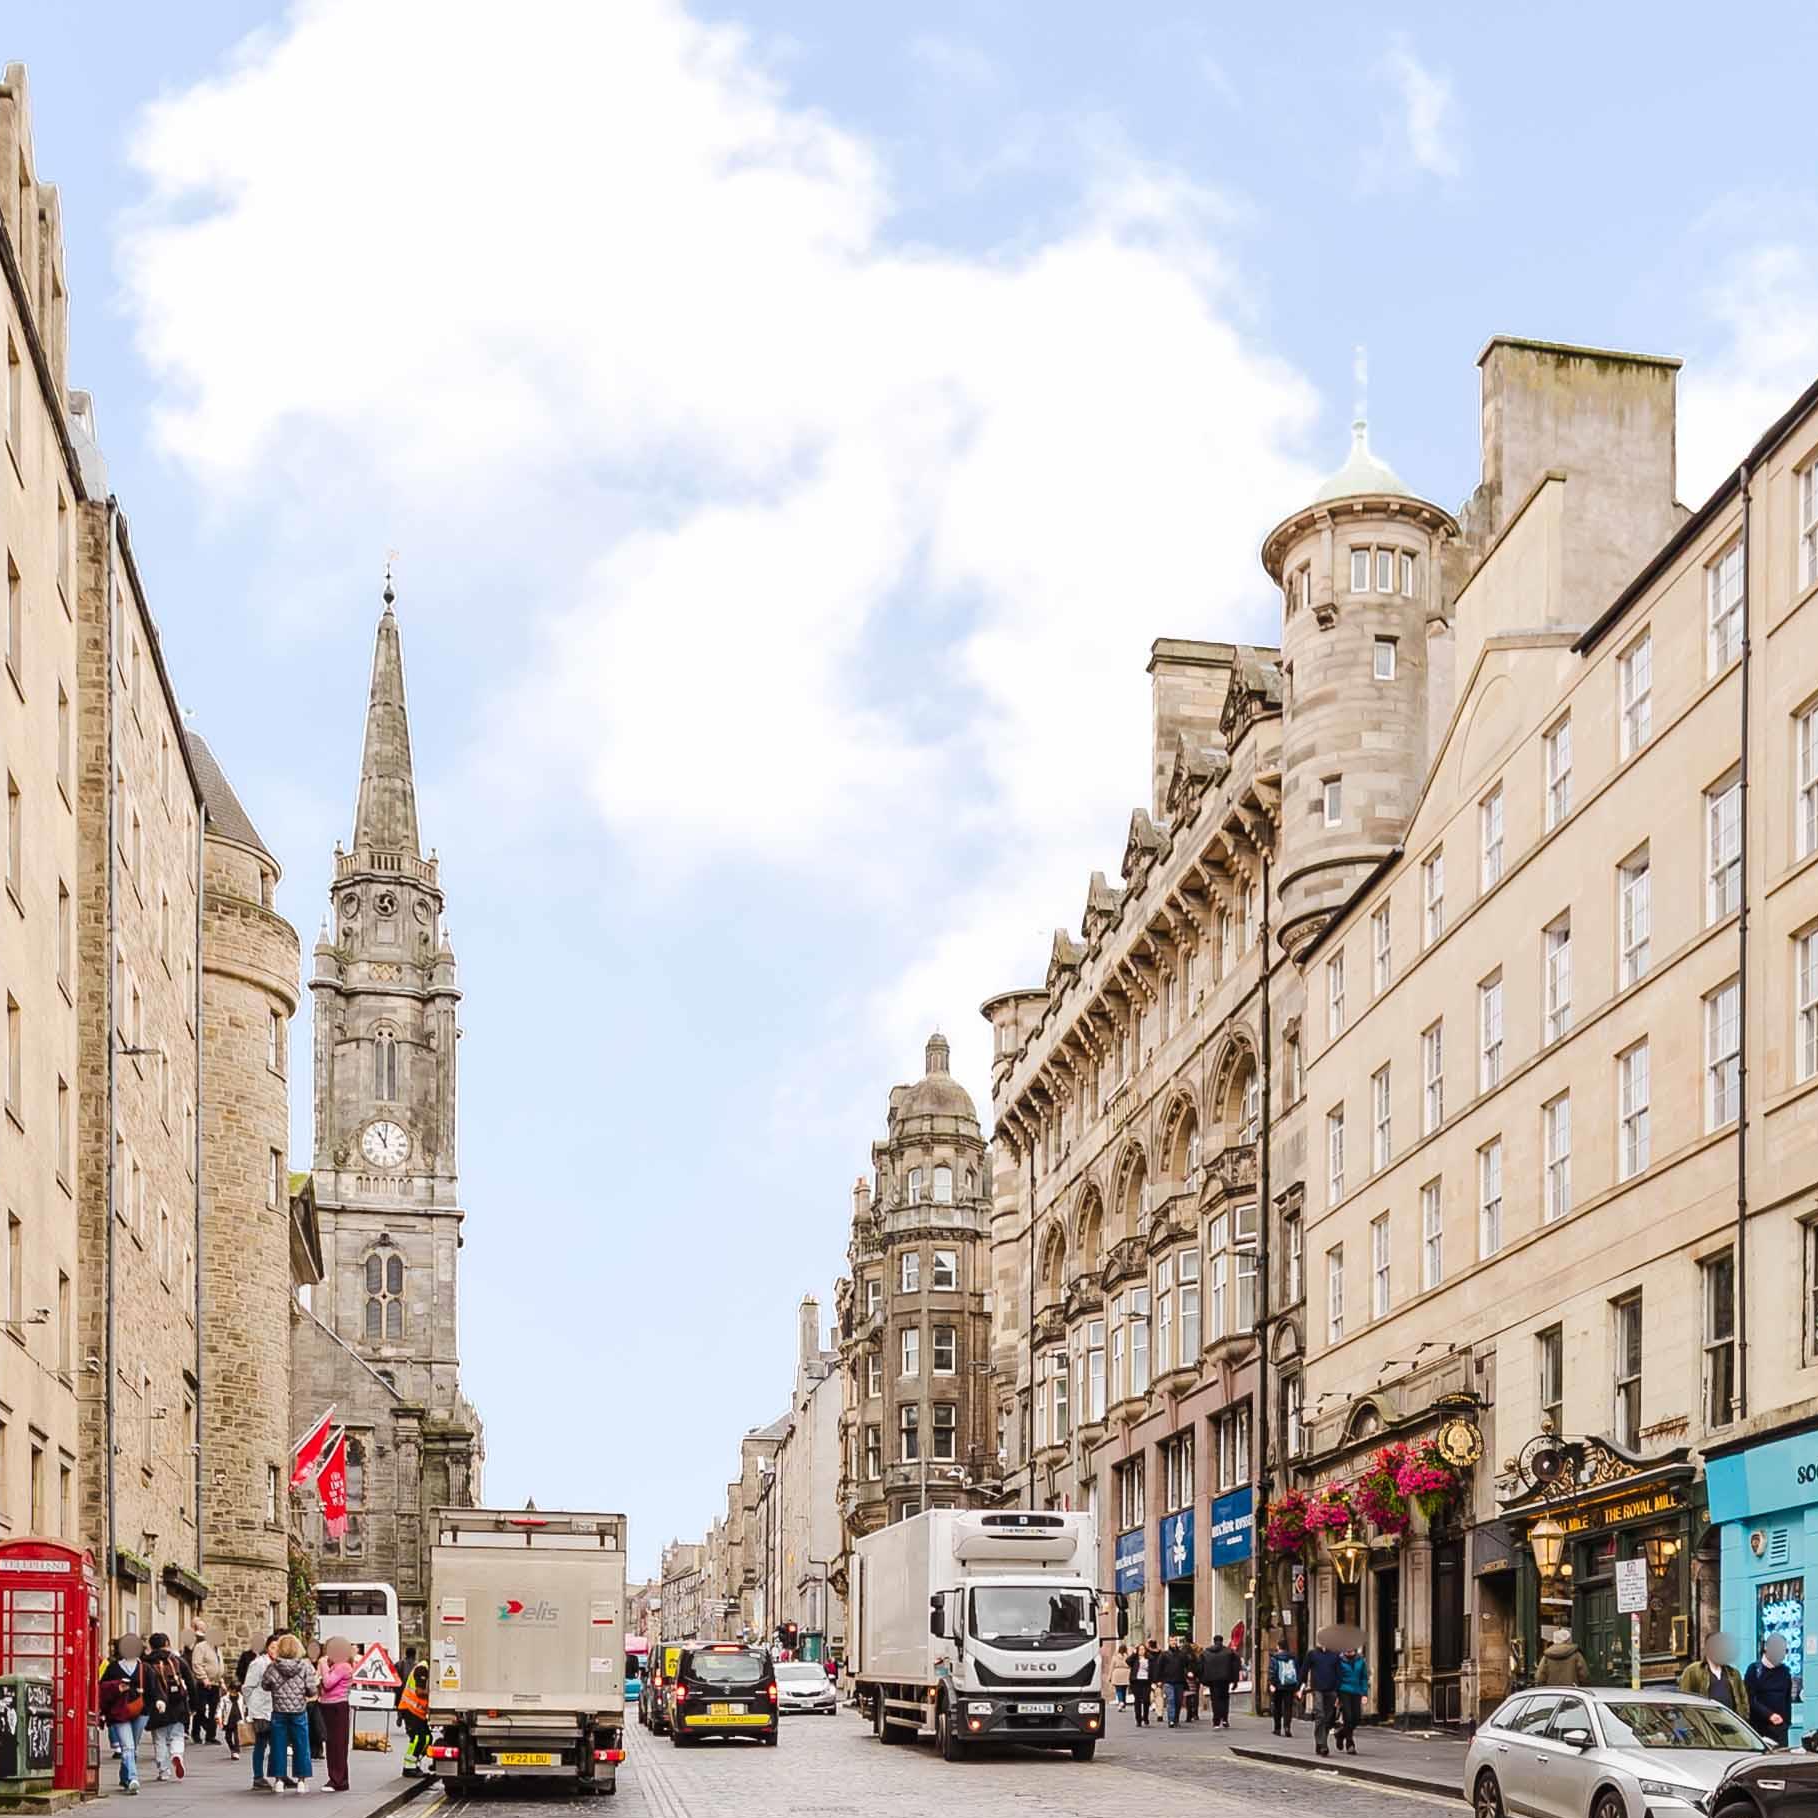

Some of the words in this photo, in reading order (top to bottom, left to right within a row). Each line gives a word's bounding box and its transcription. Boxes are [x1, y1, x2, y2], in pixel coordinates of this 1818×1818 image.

[1604, 1507, 1623, 1524] THE
[1623, 1499, 1654, 1519] ROYAL
[1, 1560, 69, 1571] TELEPHONE
[521, 1600, 560, 1622] elis
[1015, 1663, 1057, 1672] IVECO
